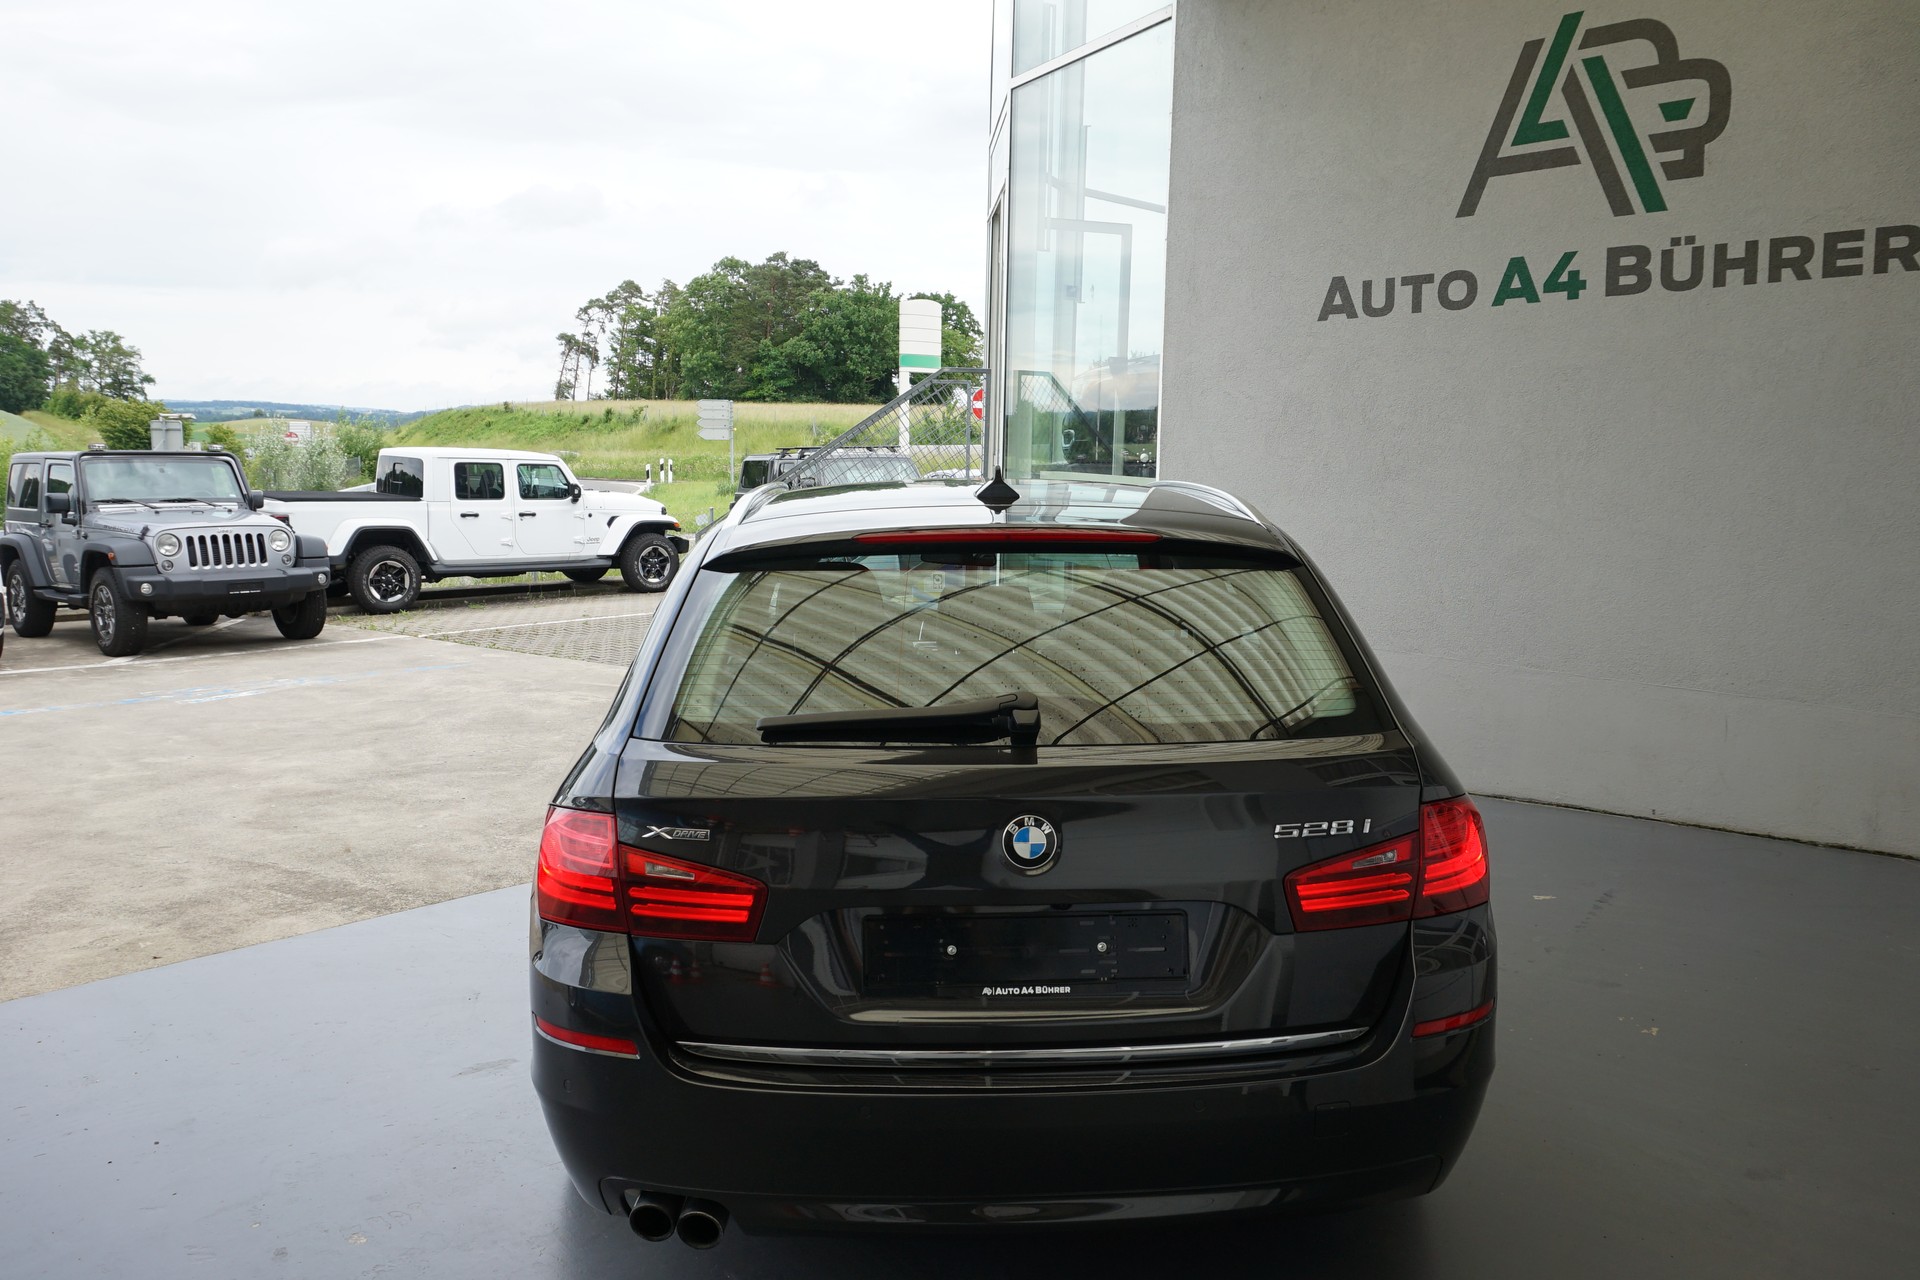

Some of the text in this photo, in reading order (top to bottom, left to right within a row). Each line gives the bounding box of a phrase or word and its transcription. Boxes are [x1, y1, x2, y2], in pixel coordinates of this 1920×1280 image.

[1317, 223, 1920, 322] AUTO A4 BÜHRER
[1007, 817, 1052, 835] BMW
[995, 986, 1020, 995] AUTO
[1021, 986, 1034, 994] A4
